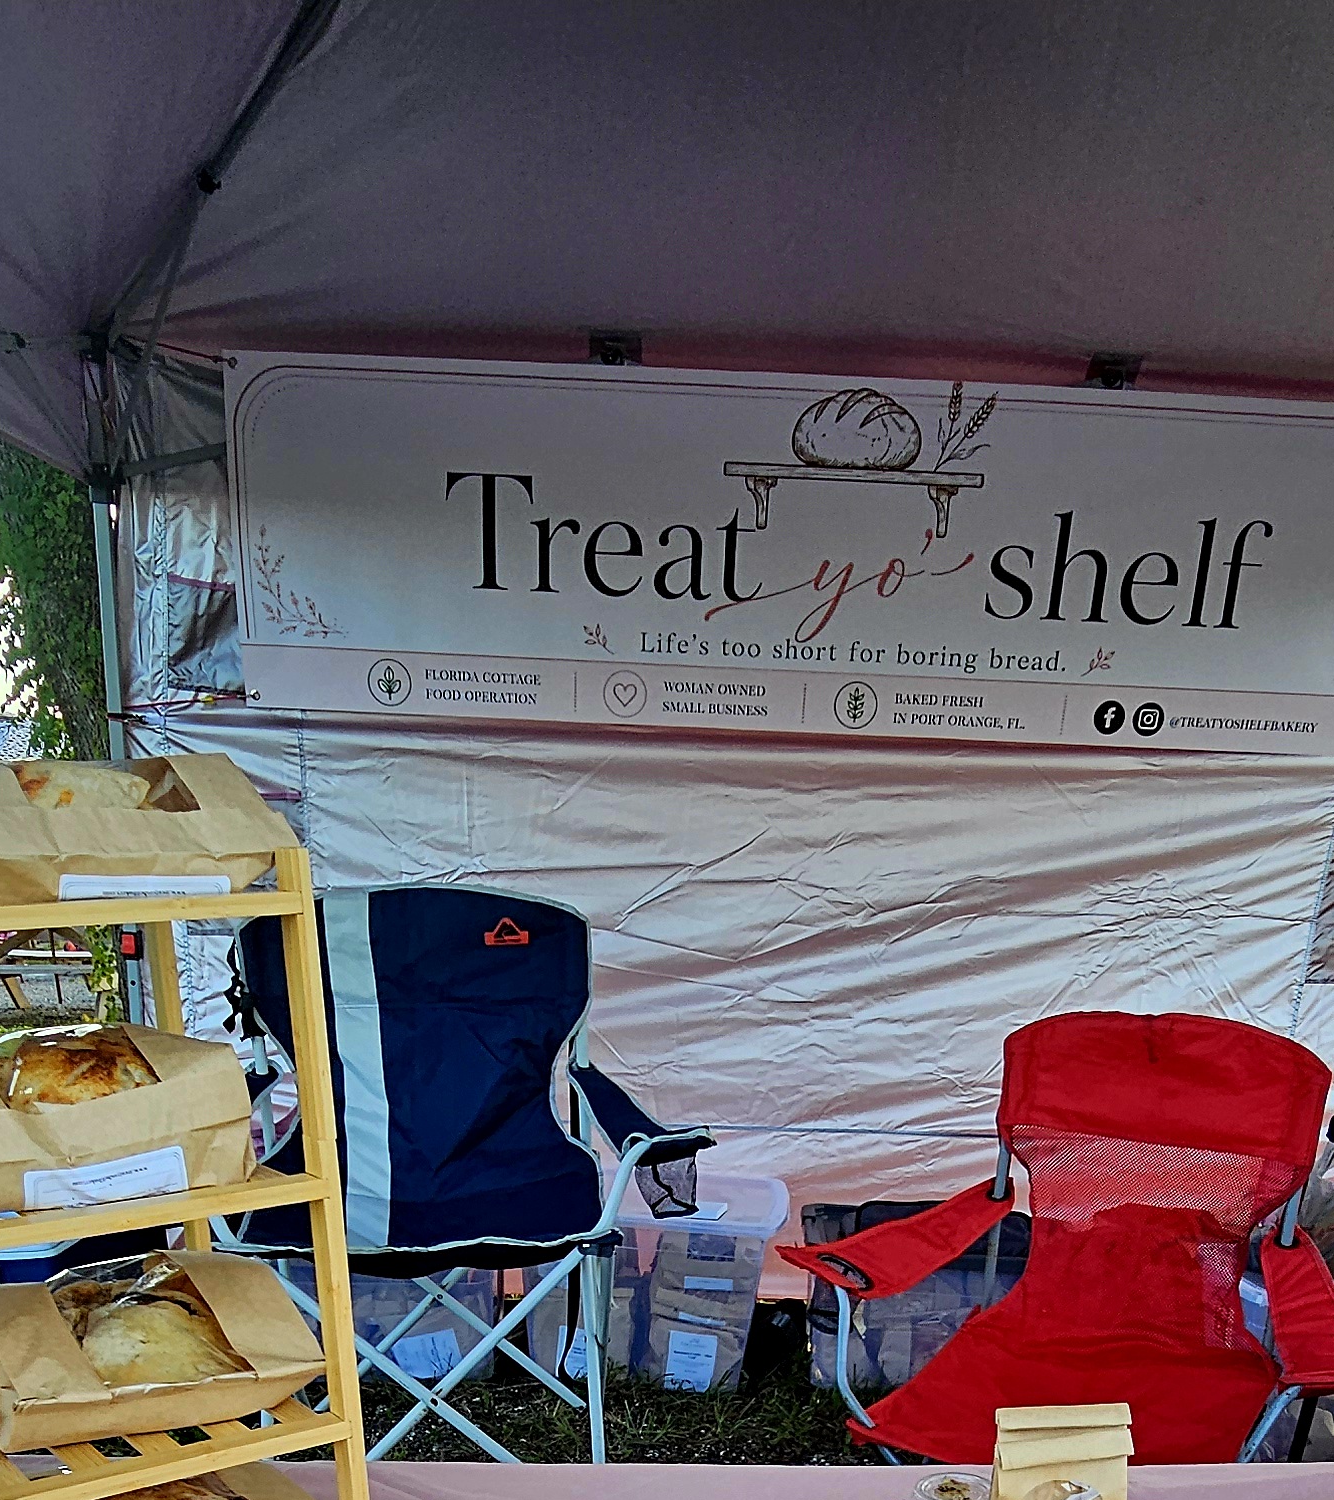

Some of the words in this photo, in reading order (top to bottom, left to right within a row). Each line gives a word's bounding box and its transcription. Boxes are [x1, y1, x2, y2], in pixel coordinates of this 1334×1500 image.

[445, 470, 763, 602] Treat
[704, 528, 975, 642] yo'
[984, 510, 1273, 629] shelf
[639, 630, 710, 656] Life's
[720, 637, 761, 658] too
[772, 640, 837, 663] short
[849, 640, 886, 664] for
[896, 643, 978, 674] boring
[989, 645, 1067, 672] bread.
[424, 668, 480, 684] FLORIDA
[482, 671, 541, 687] COTTAGE
[425, 687, 463, 702] FOOD
[464, 688, 538, 706] OPERATION
[663, 680, 715, 697] WOMAN
[717, 682, 767, 699] OWNED
[661, 699, 706, 715] SMALL
[708, 702, 768, 718] BUSINESS
[894, 692, 938, 707] BAKED
[941, 695, 984, 708] FRESH
[893, 712, 907, 725] IN
[910, 714, 946, 727] PORT
[948, 716, 1004, 730] ORANGE,
[1007, 718, 1026, 730] FL.
[1169, 716, 1319, 734] @TREATYOSHELFBAKERY
